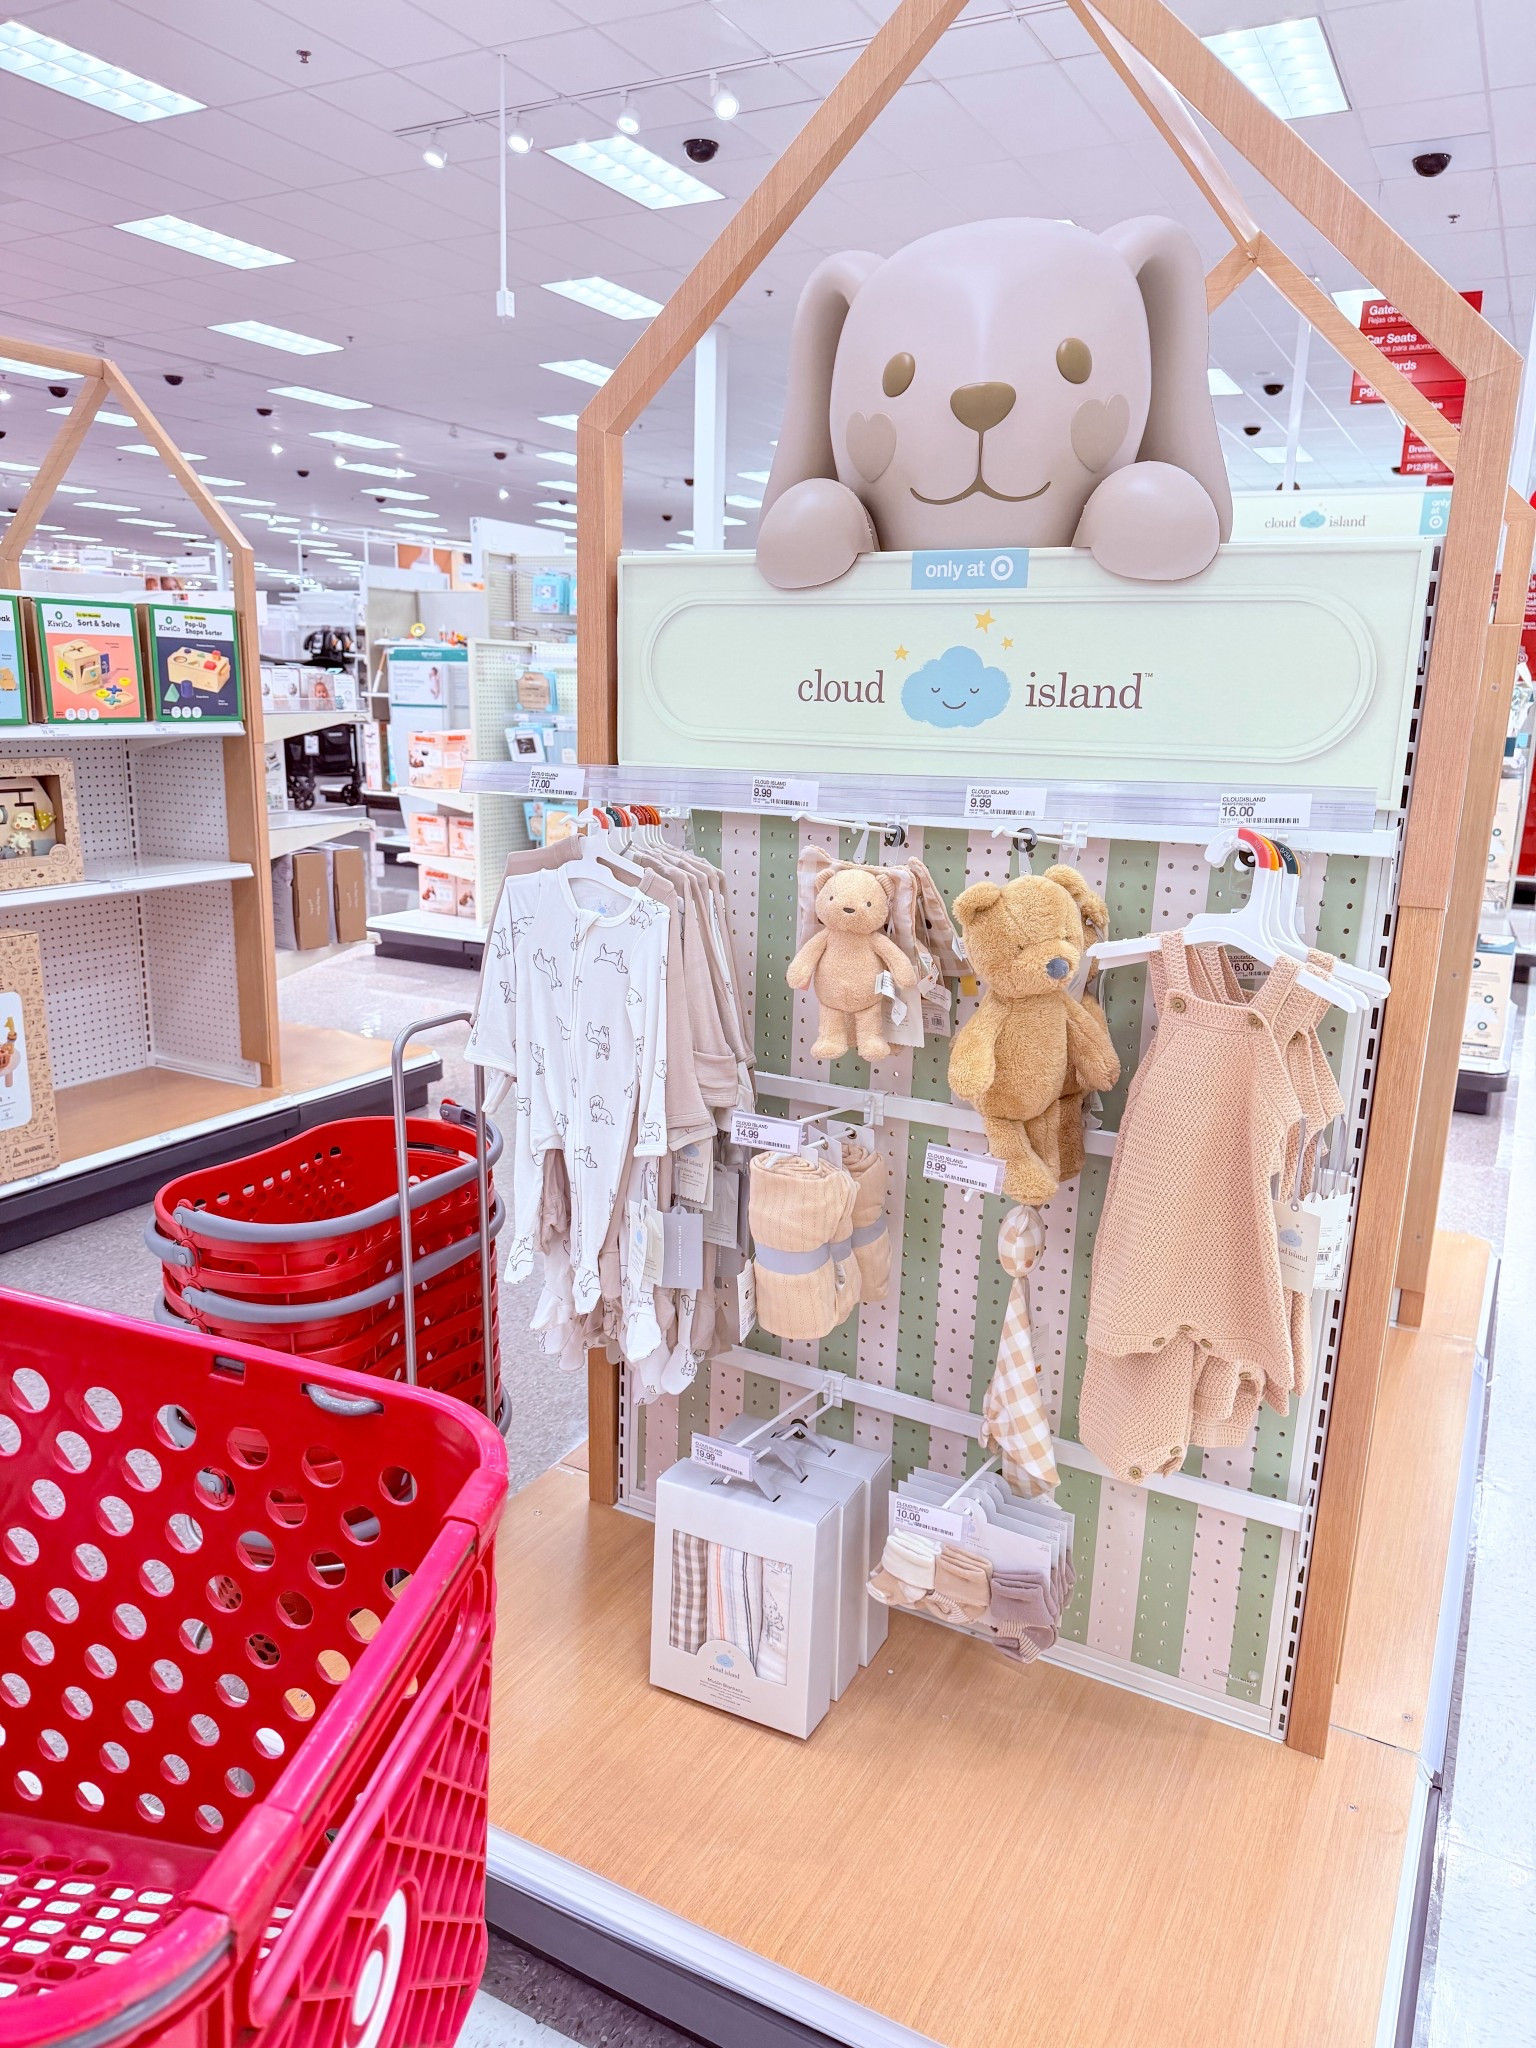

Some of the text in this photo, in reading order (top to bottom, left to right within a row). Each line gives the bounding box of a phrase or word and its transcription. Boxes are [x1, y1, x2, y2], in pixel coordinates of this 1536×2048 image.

[1386, 333, 1417, 343] Seats
[1264, 515, 1366, 529] cloud island
[925, 561, 985, 581] only at
[47, 620, 73, 628] KiwiCo
[77, 619, 93, 627] Sort
[101, 620, 121, 628] Solve
[158, 624, 181, 632] KiwiCo
[184, 621, 207, 629] Pop-Up
[185, 628, 204, 636] Shape
[798, 669, 885, 704] cloud
[531, 779, 550, 789] 17.00
[753, 787, 772, 798] 9.99
[970, 797, 992, 808] 9.99
[1222, 806, 1255, 817] 16.00
[736, 1128, 759, 1139] 14.99
[926, 1160, 947, 1173] 9.99
[695, 1449, 716, 1461] 19.99
[896, 1508, 921, 1522] 10.00
